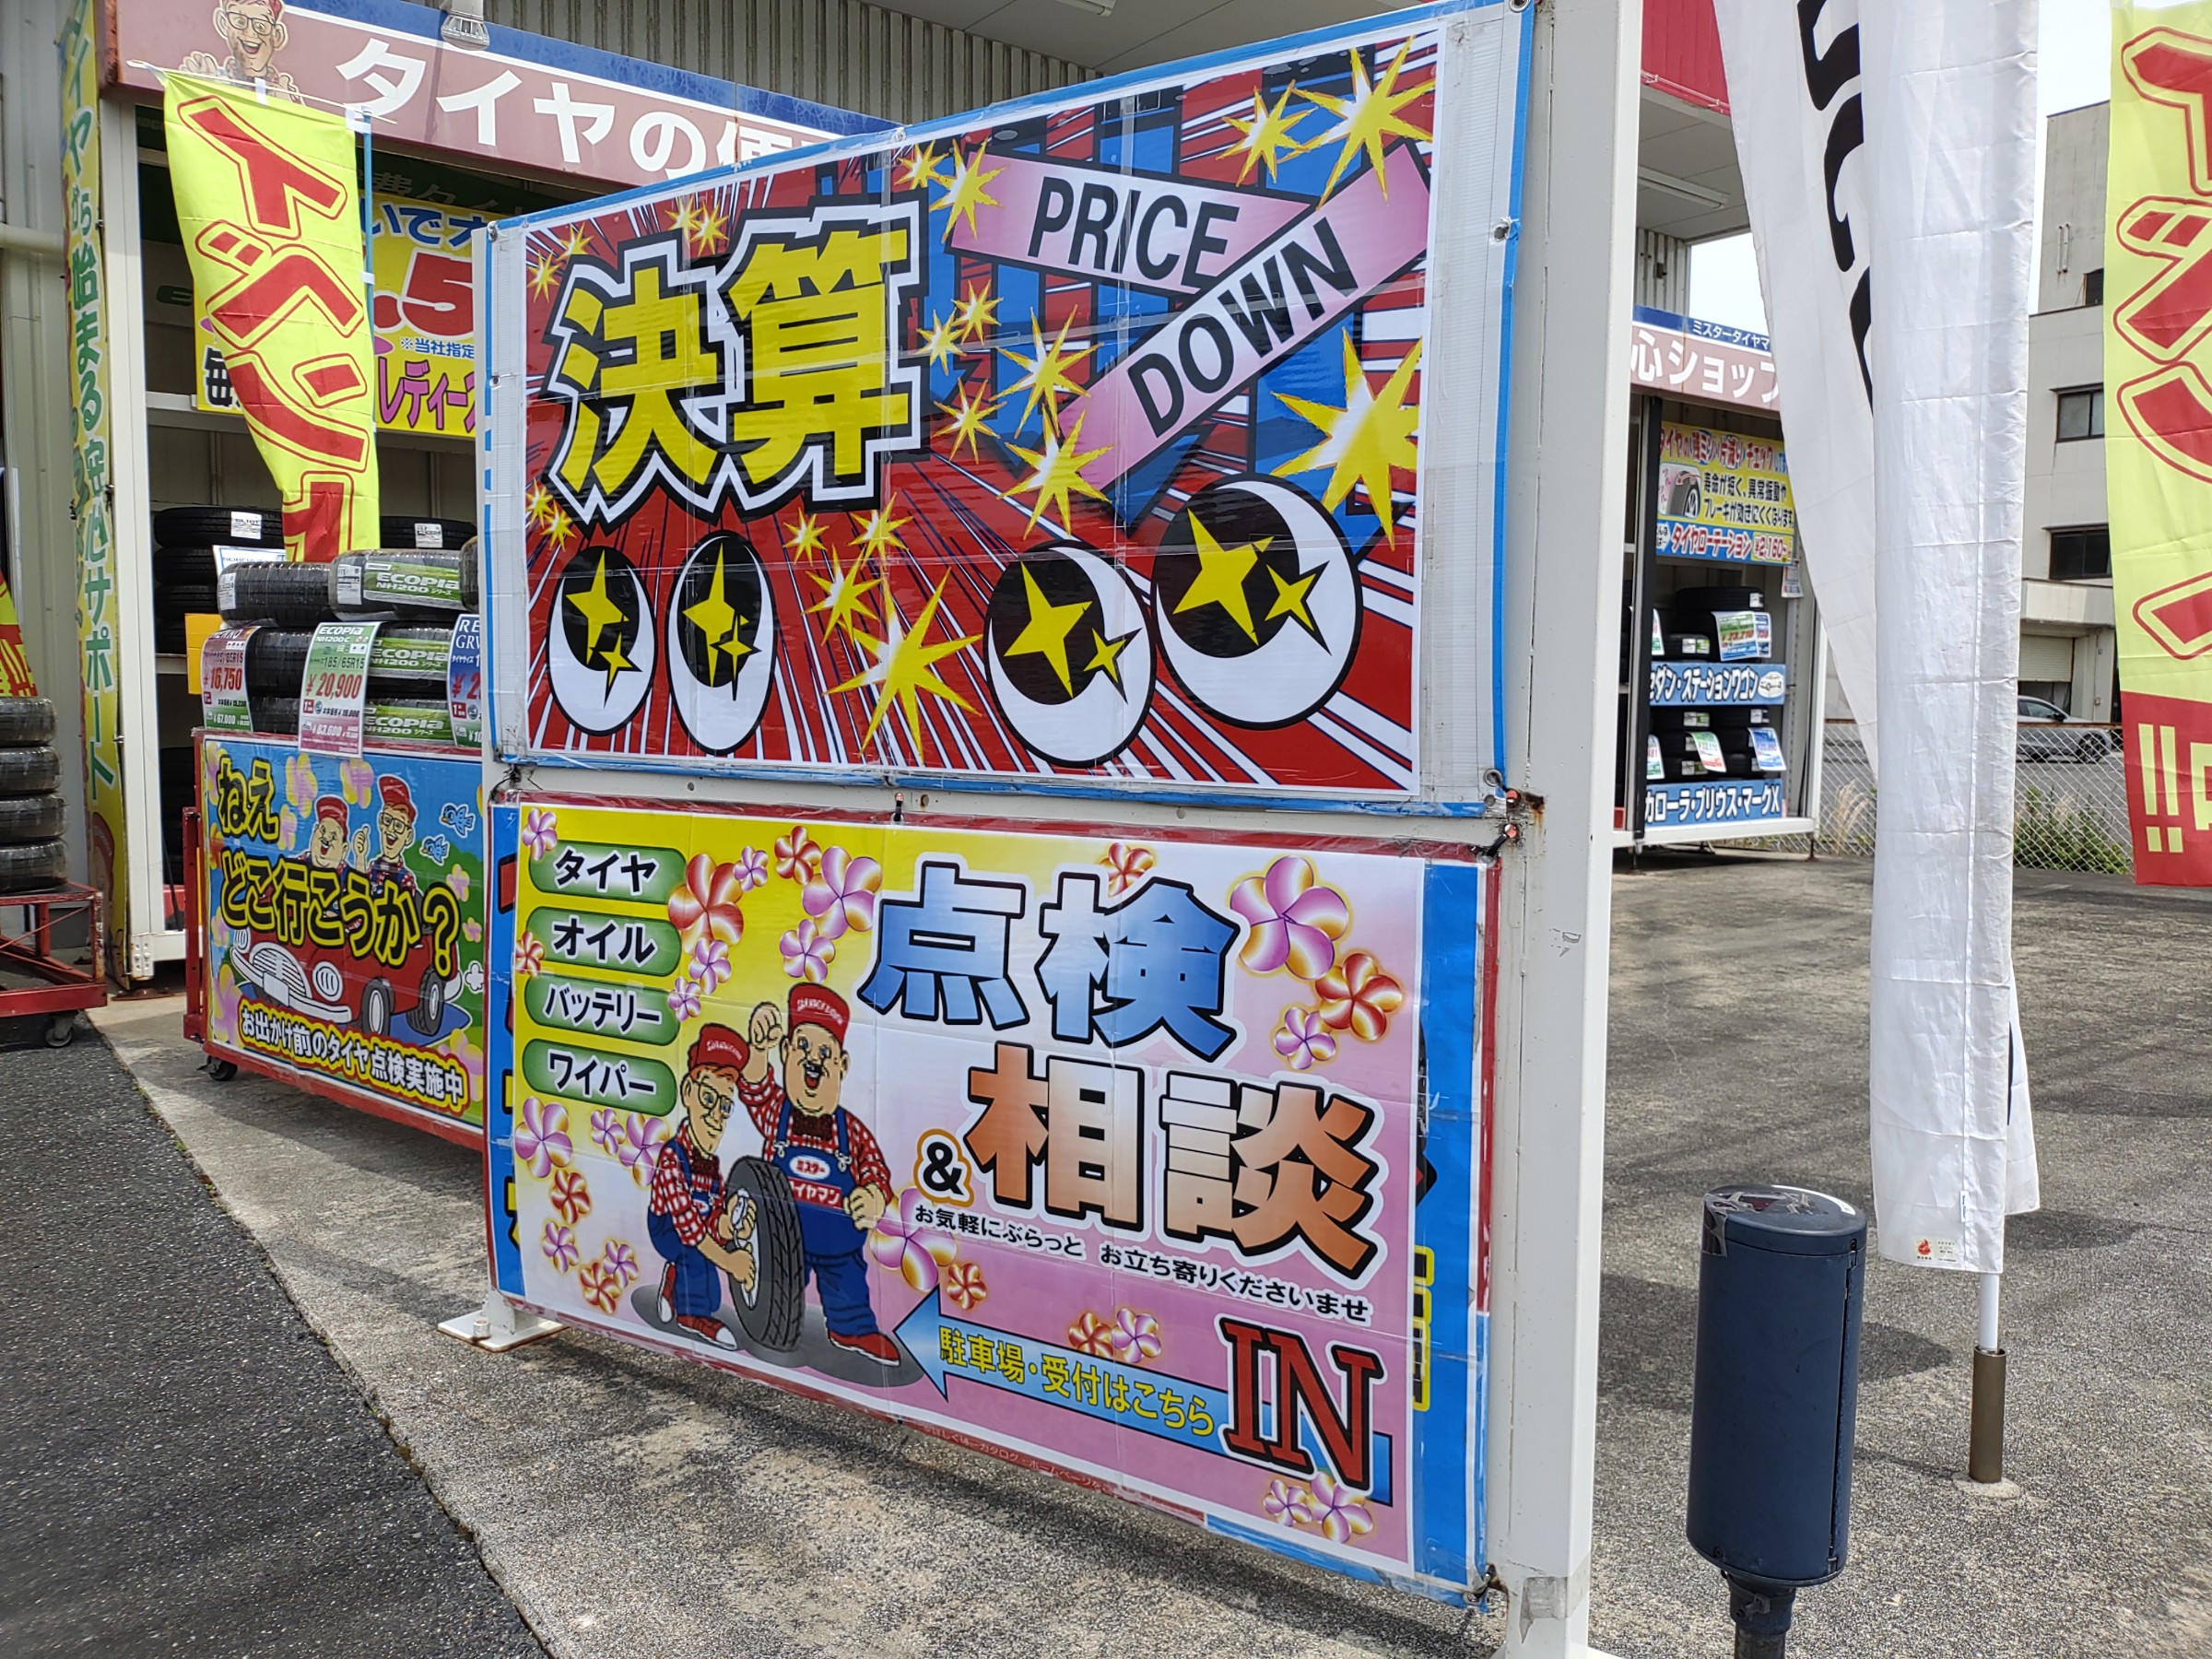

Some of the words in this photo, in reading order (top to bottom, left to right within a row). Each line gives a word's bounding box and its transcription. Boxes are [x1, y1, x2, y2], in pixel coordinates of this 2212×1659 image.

[1026, 177, 1240, 290] PRICE
[548, 205, 924, 516] 決算
[1126, 218, 1359, 437] DOWN
[375, 582, 429, 594] NH200
[1671, 523, 1752, 559] タイヤローテーション
[318, 627, 365, 636] ECOPIA
[218, 758, 280, 840] ねえ
[221, 851, 460, 977] どこ行こうか?
[554, 848, 657, 895] タイヤ
[552, 916, 656, 967] オイル
[857, 861, 1240, 1063] 点検
[240, 1008, 467, 1104] お出かけ前のタイヤ点検実施中
[544, 989, 662, 1034] バッテリー
[547, 1049, 655, 1097] ワイパー
[923, 1141, 963, 1197] &
[963, 1041, 1377, 1277] 相談
[914, 1204, 1085, 1258] お気軽にぶらっと
[1100, 1244, 1370, 1322] お立ち寄りくださいませ
[938, 1325, 1215, 1438] 駐車場・受付はこちら
[1219, 1316, 1384, 1490] IN
